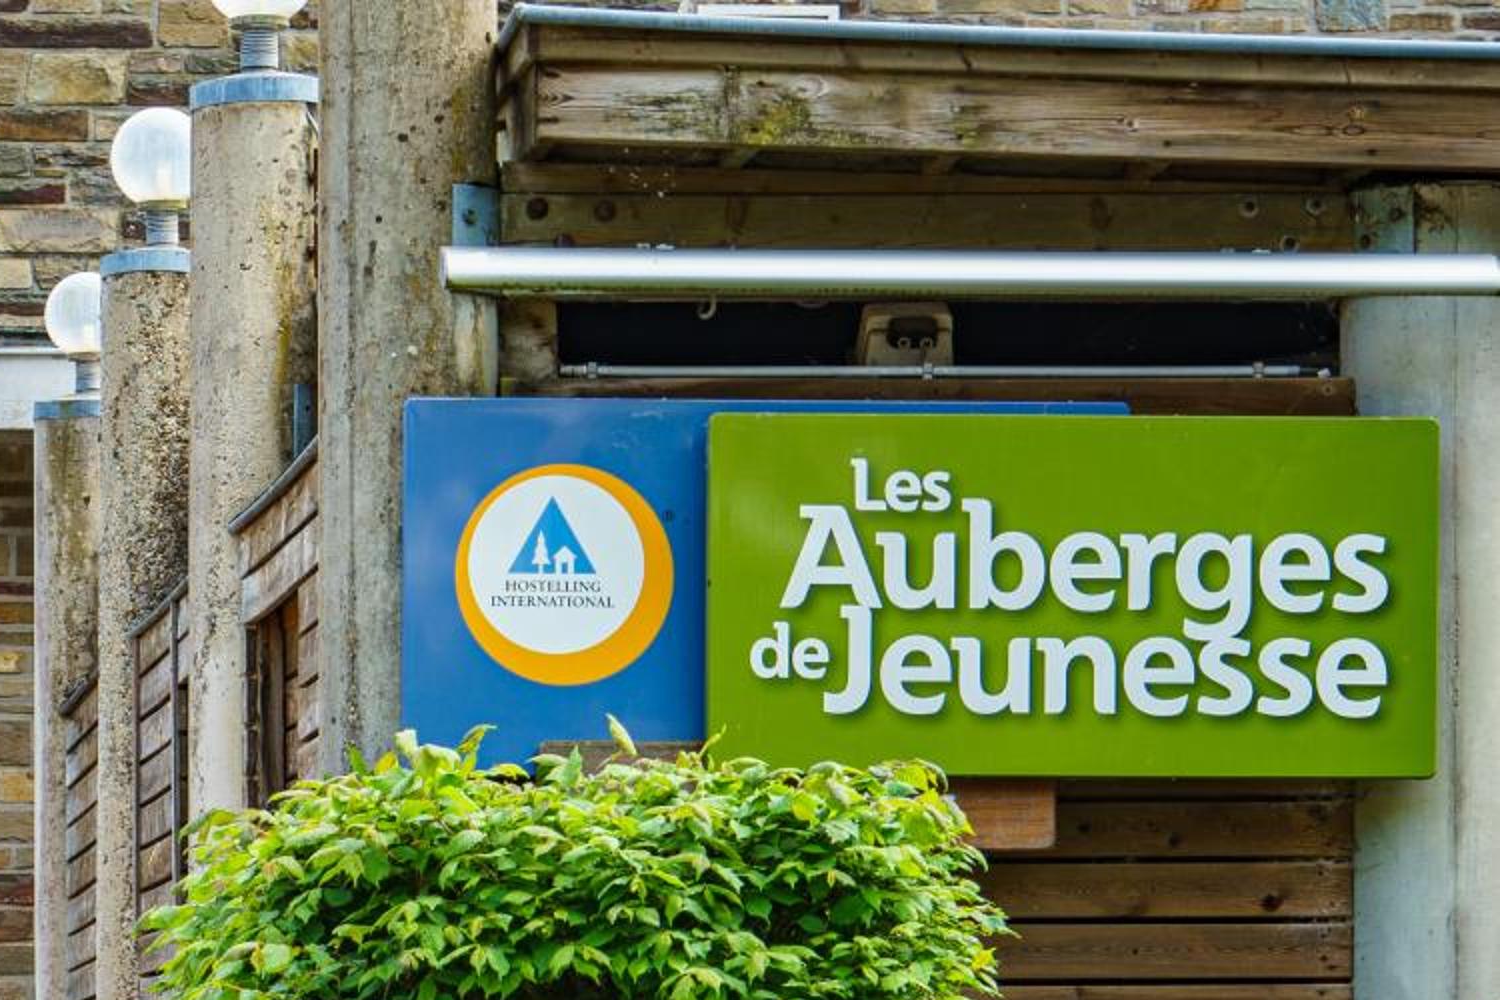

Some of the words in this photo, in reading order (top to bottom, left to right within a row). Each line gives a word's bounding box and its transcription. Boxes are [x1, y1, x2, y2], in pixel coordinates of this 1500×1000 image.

[851, 457, 951, 512] Les
[505, 579, 602, 593] HOSTELLING
[779, 498, 1390, 642] Auberges
[490, 595, 615, 609] INTERNATIONAL
[750, 620, 830, 679] de
[823, 604, 1389, 719] Jeunesse
